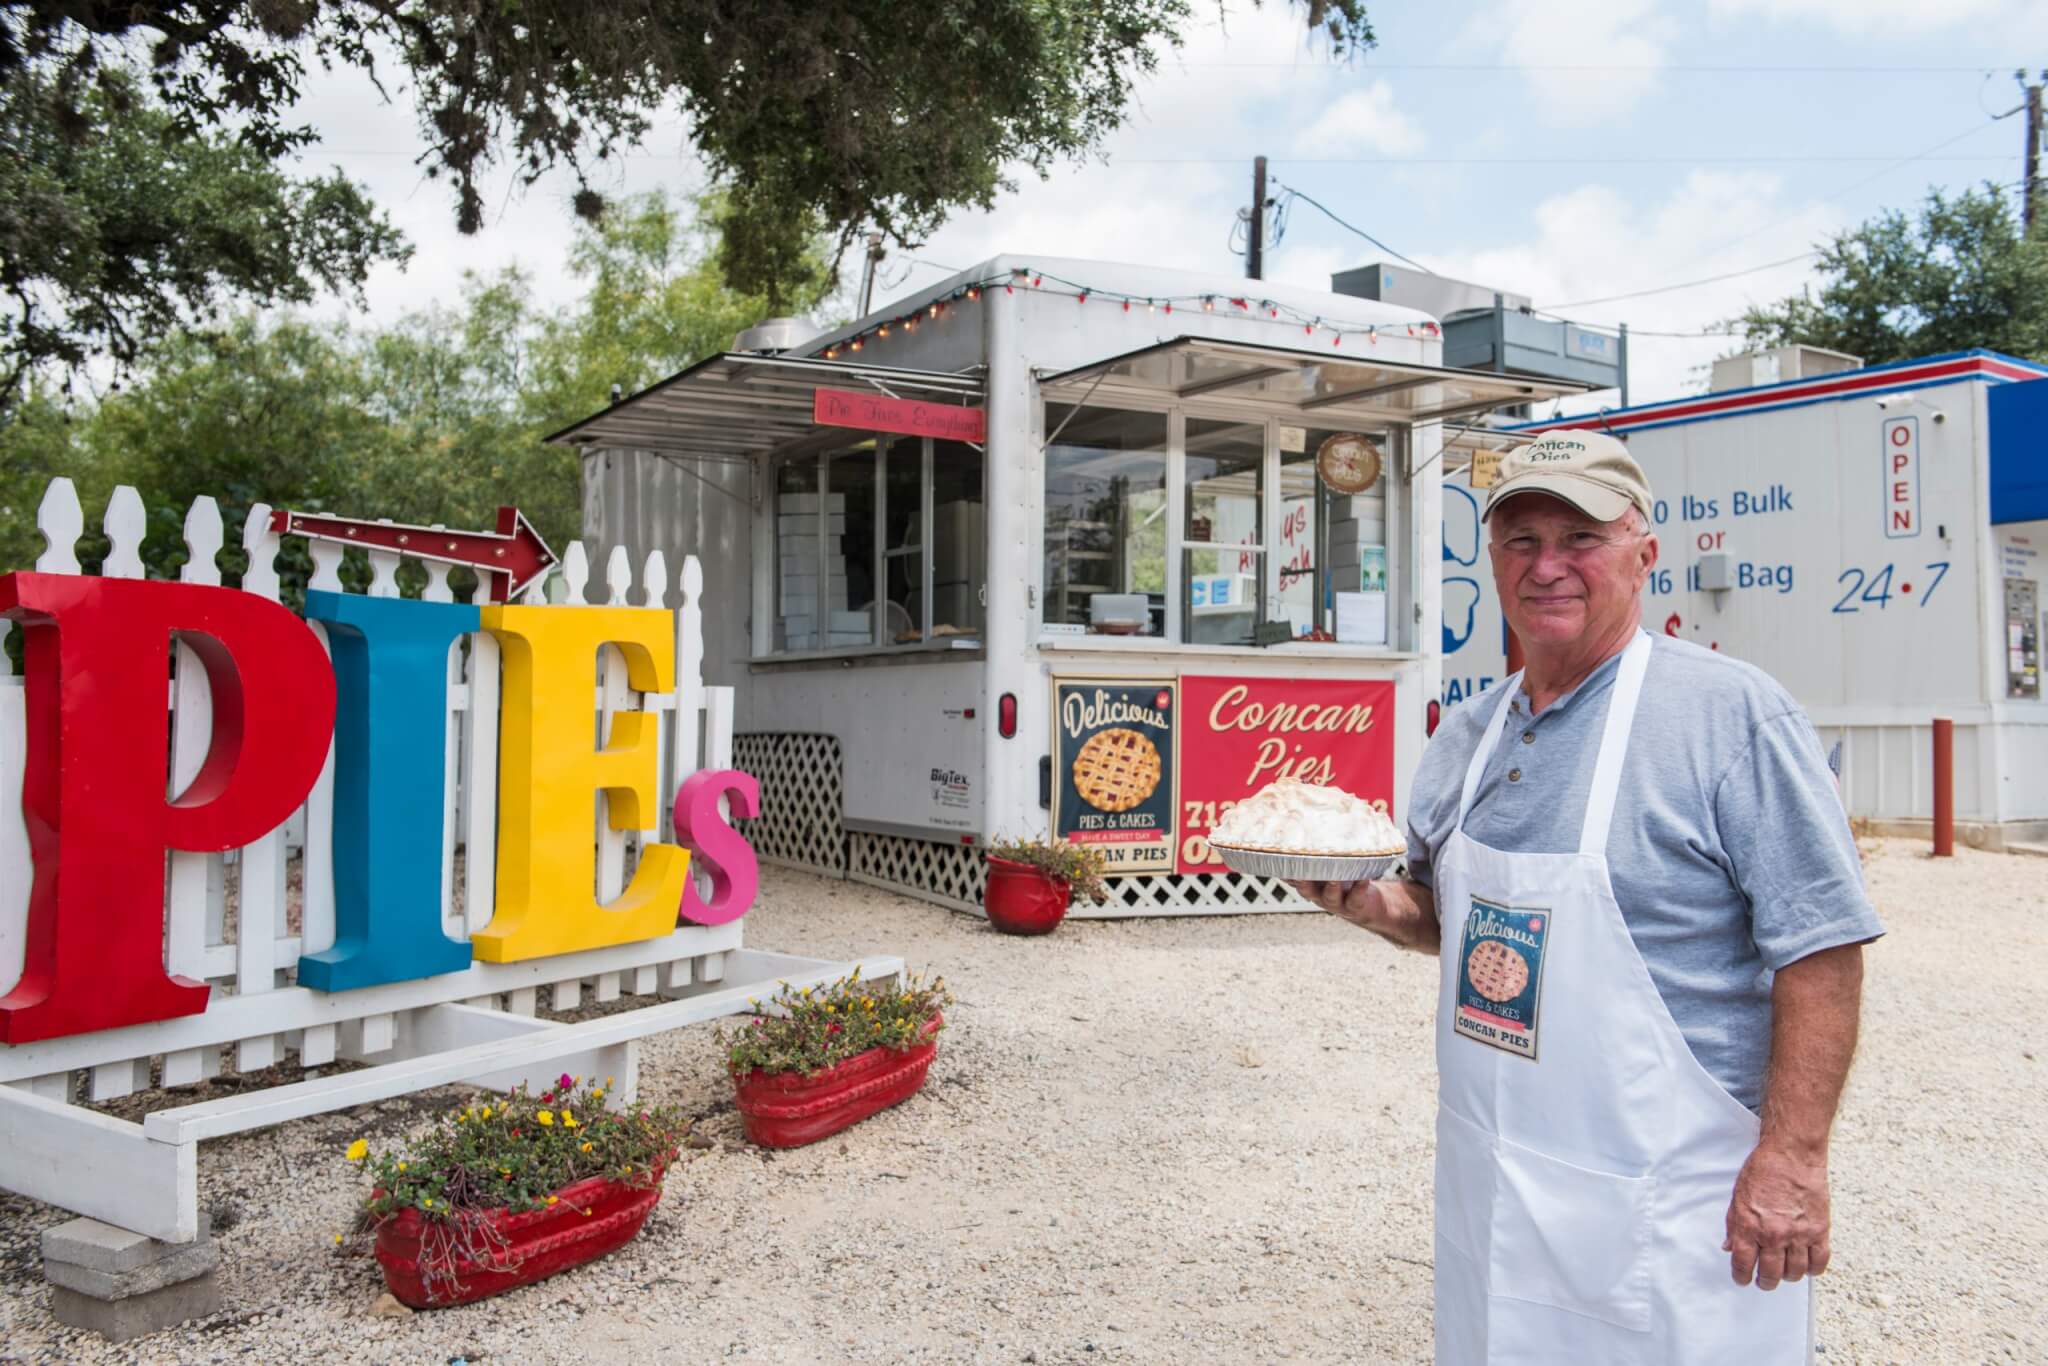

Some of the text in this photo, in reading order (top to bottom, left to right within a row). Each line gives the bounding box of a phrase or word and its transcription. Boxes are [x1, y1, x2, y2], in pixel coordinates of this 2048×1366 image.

[1891, 425, 1911, 530] OPEN
[1654, 484, 1793, 524] 0 lbs Bulk
[1697, 531, 1726, 551] or
[1649, 569, 1673, 595] 16
[1738, 562, 1793, 593] Bag
[1063, 689, 1169, 738] Delicious
[1209, 684, 1374, 733] Concan
[1246, 737, 1336, 787] Pies
[1079, 813, 1156, 829] PIES & CAKES
[1135, 831, 1151, 840] DAY
[1132, 847, 1168, 861] PIES
[1468, 907, 1539, 949] Delicious
[1458, 1016, 1497, 1038] CONCAN
[1501, 1031, 1529, 1049] PIES
